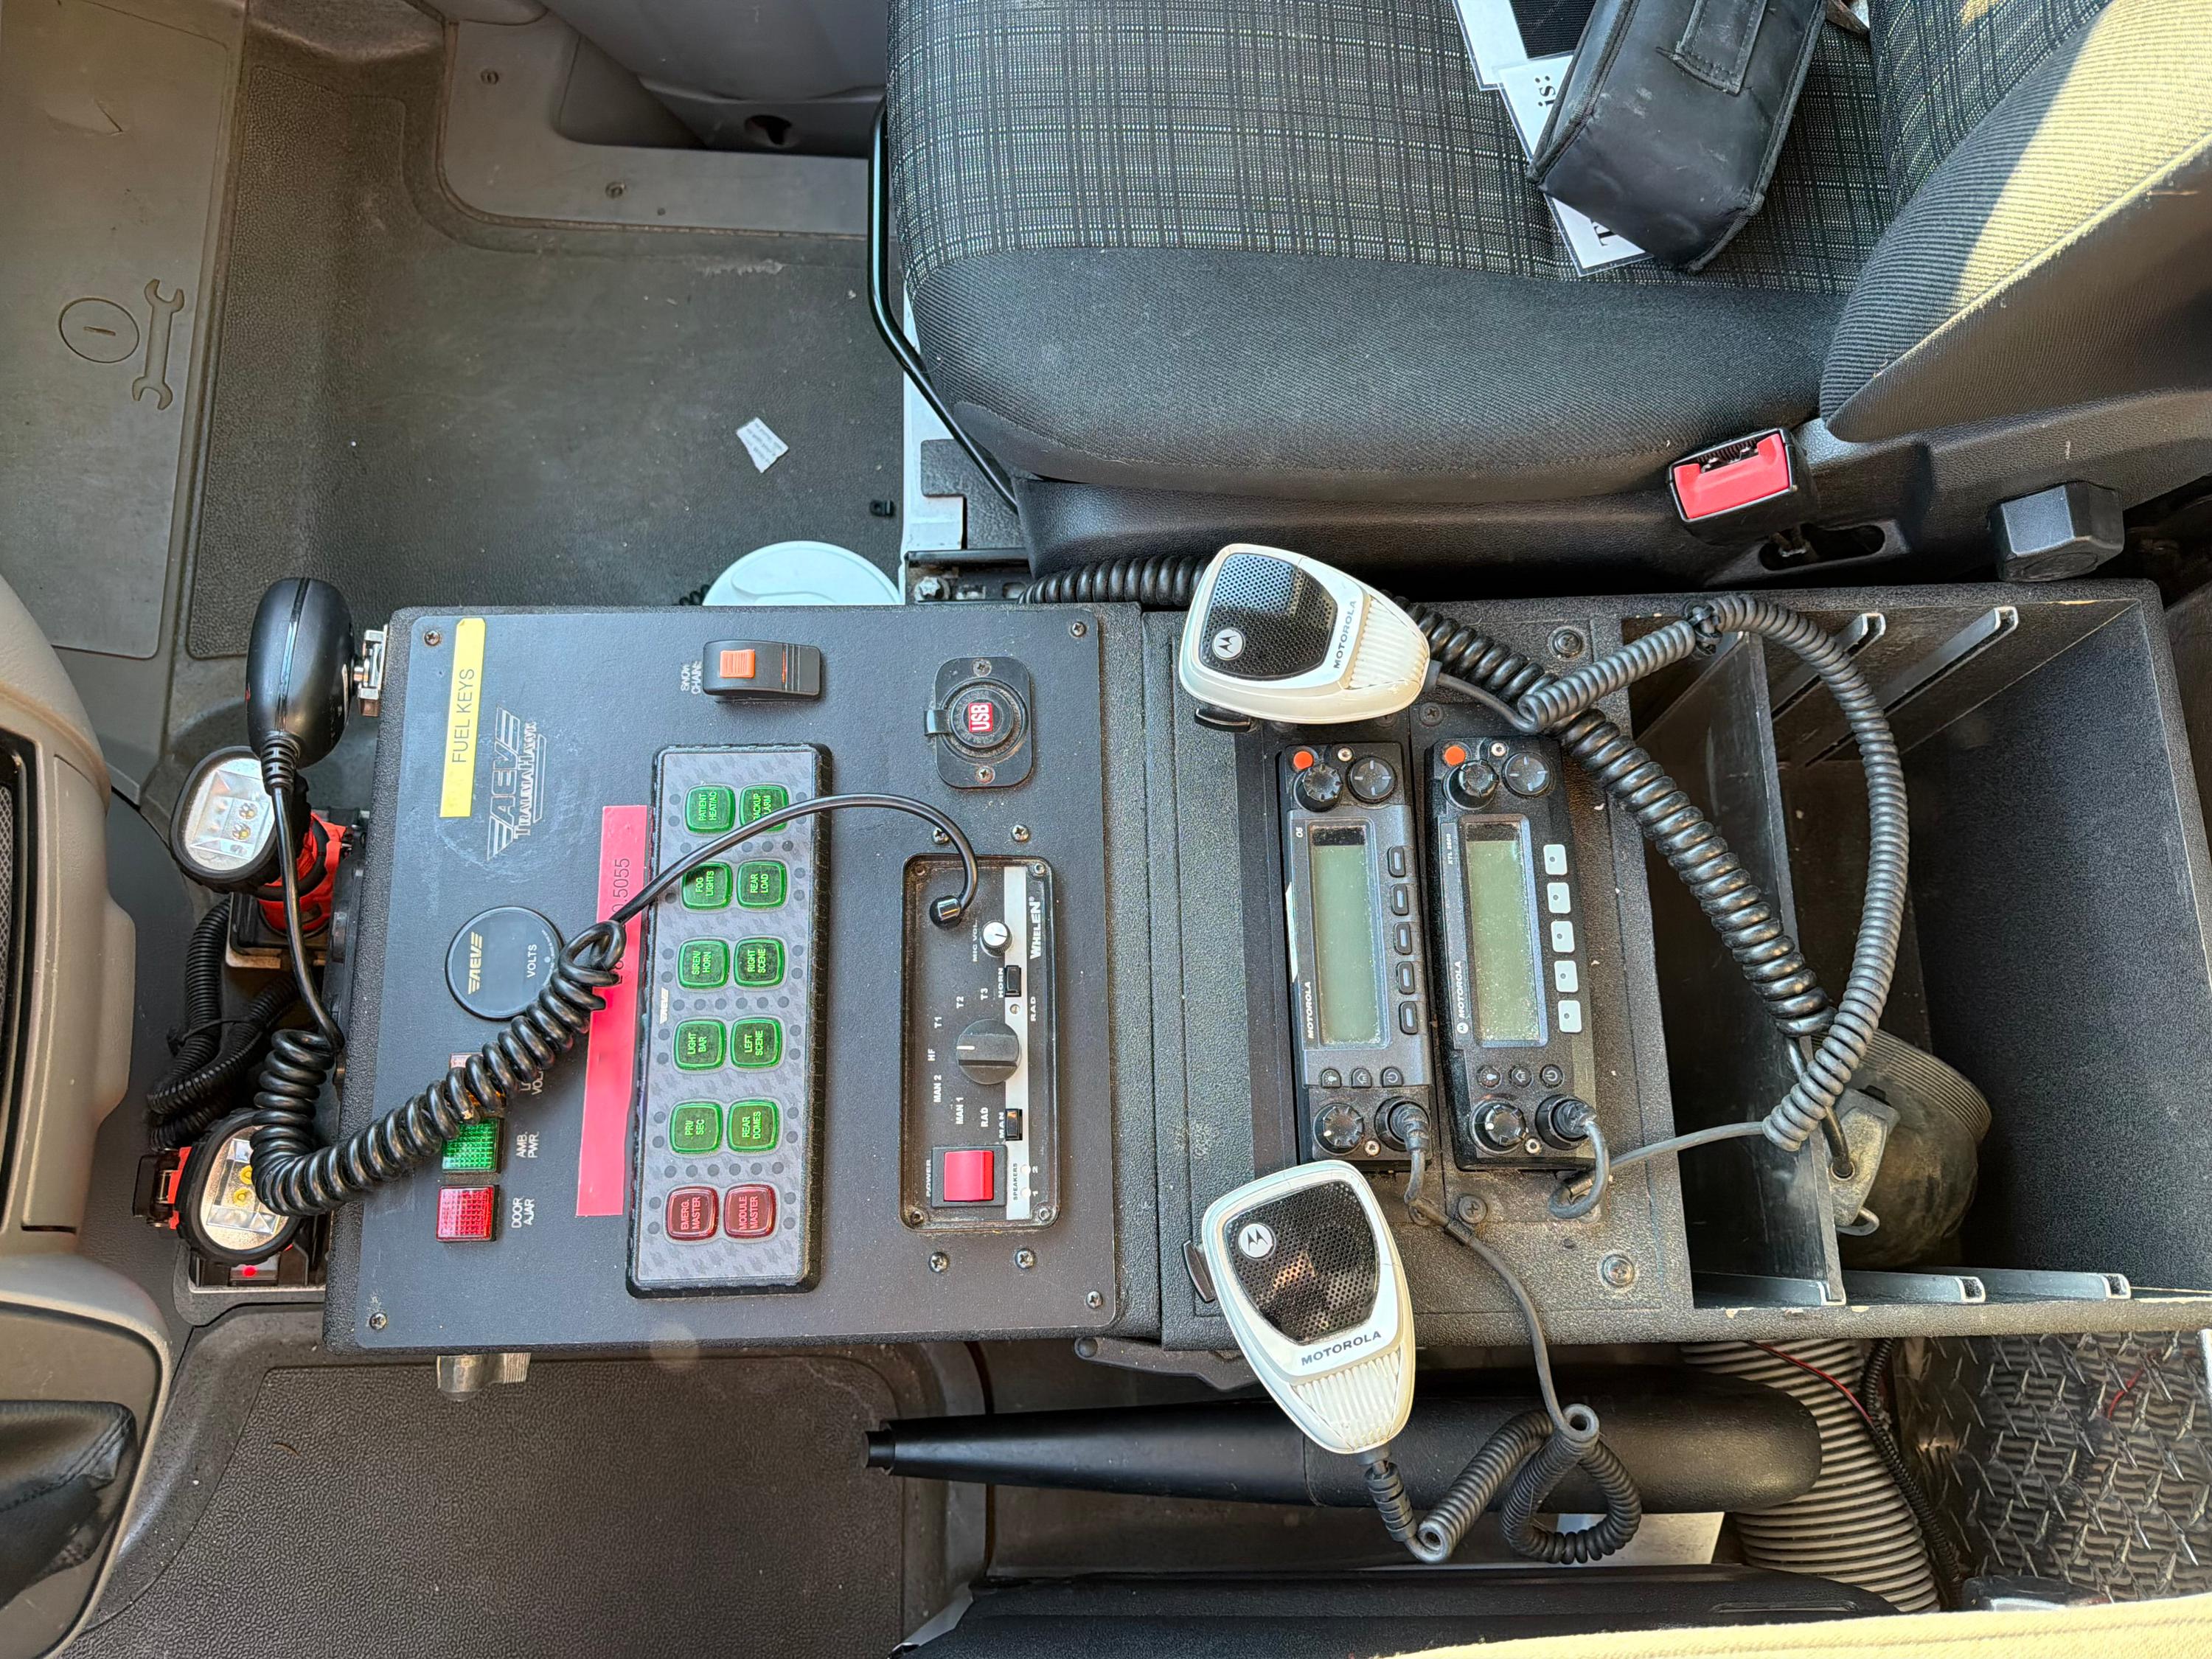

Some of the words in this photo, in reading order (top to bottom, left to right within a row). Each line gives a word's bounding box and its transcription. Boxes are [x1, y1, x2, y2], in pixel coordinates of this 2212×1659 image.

[1333, 600, 1357, 669] MOTOROLA
[456, 669, 474, 713] KEYS
[681, 664, 690, 692] SNOW
[970, 705, 990, 731] USB
[452, 720, 470, 763] FUEL
[709, 791, 717, 820] HEAT/AC
[763, 795, 771, 814] LARM
[695, 877, 703, 893] FOG
[706, 871, 714, 897] LIGHTS
[527, 945, 537, 978] VOLTS
[692, 951, 701, 975] SIREN/
[703, 951, 712, 973] HORN
[747, 950, 756, 972] RIGHT
[758, 948, 766, 973] SCENE
[956, 996, 964, 1009] T2
[981, 988, 988, 1000] T3
[1455, 961, 1465, 1018] MOTOROLA
[1304, 981, 1314, 1038] MOTOROLA
[934, 1017, 942, 1029] T1
[687, 1032, 696, 1055] LIGHT
[698, 1037, 707, 1052] BAR
[745, 1034, 753, 1053] LEFT
[755, 1030, 763, 1056] SCENE
[928, 1048, 936, 1061] HF
[933, 1087, 942, 1102] MAN
[685, 1120, 693, 1135] PRI/
[753, 1111, 761, 1139] DOMES
[956, 1109, 964, 1124] MAN
[981, 1107, 989, 1127] RAD
[516, 1131, 528, 1158] AMB.
[528, 1131, 540, 1158] PWR.
[512, 1197, 524, 1228] DOOR
[524, 1198, 535, 1225] AJAR
[681, 1200, 689, 1230] EMERG.
[692, 1197, 700, 1229] MASTER
[739, 1196, 748, 1230] MODULE
[750, 1196, 758, 1228] MASTER
[1301, 1331, 1382, 1366] MOTOROLA
